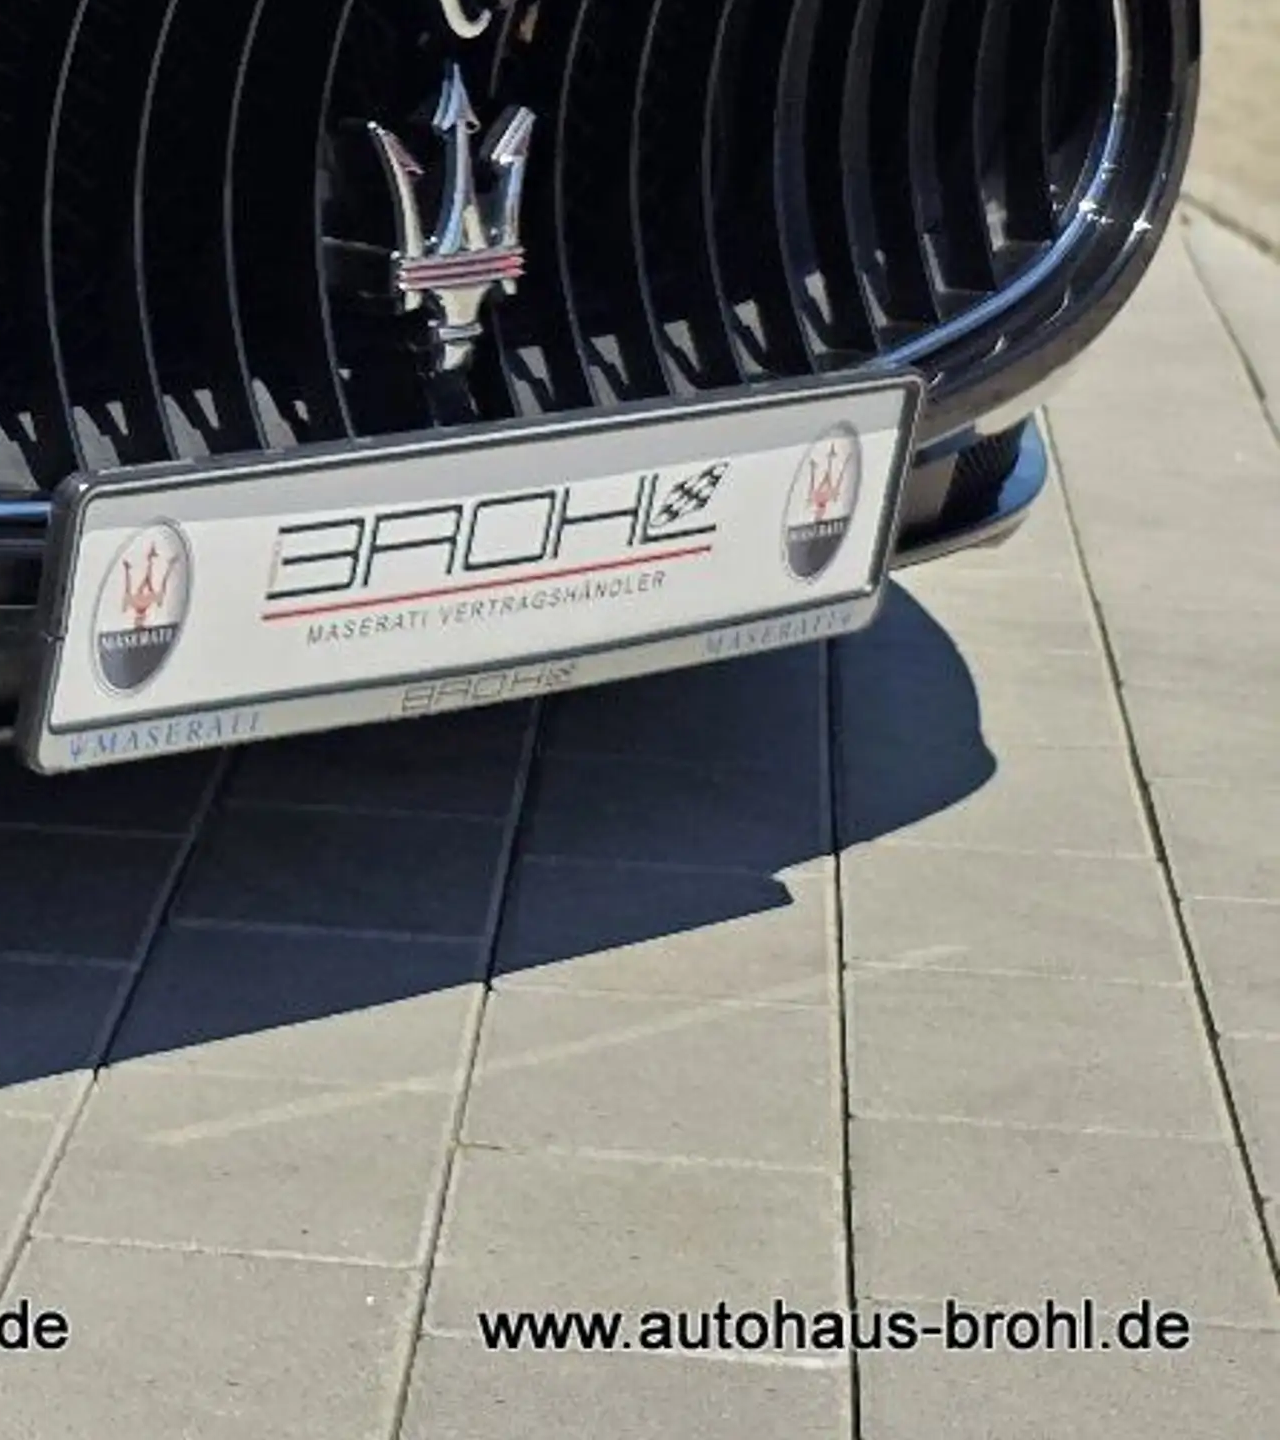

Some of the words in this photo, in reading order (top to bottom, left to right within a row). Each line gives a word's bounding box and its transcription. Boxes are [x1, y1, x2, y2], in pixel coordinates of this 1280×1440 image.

[264, 471, 719, 601] BROHL
[307, 610, 430, 645] MASERATI
[438, 569, 668, 625] VERTRAGSHÄNDLER
[93, 710, 264, 758] MASERATI
